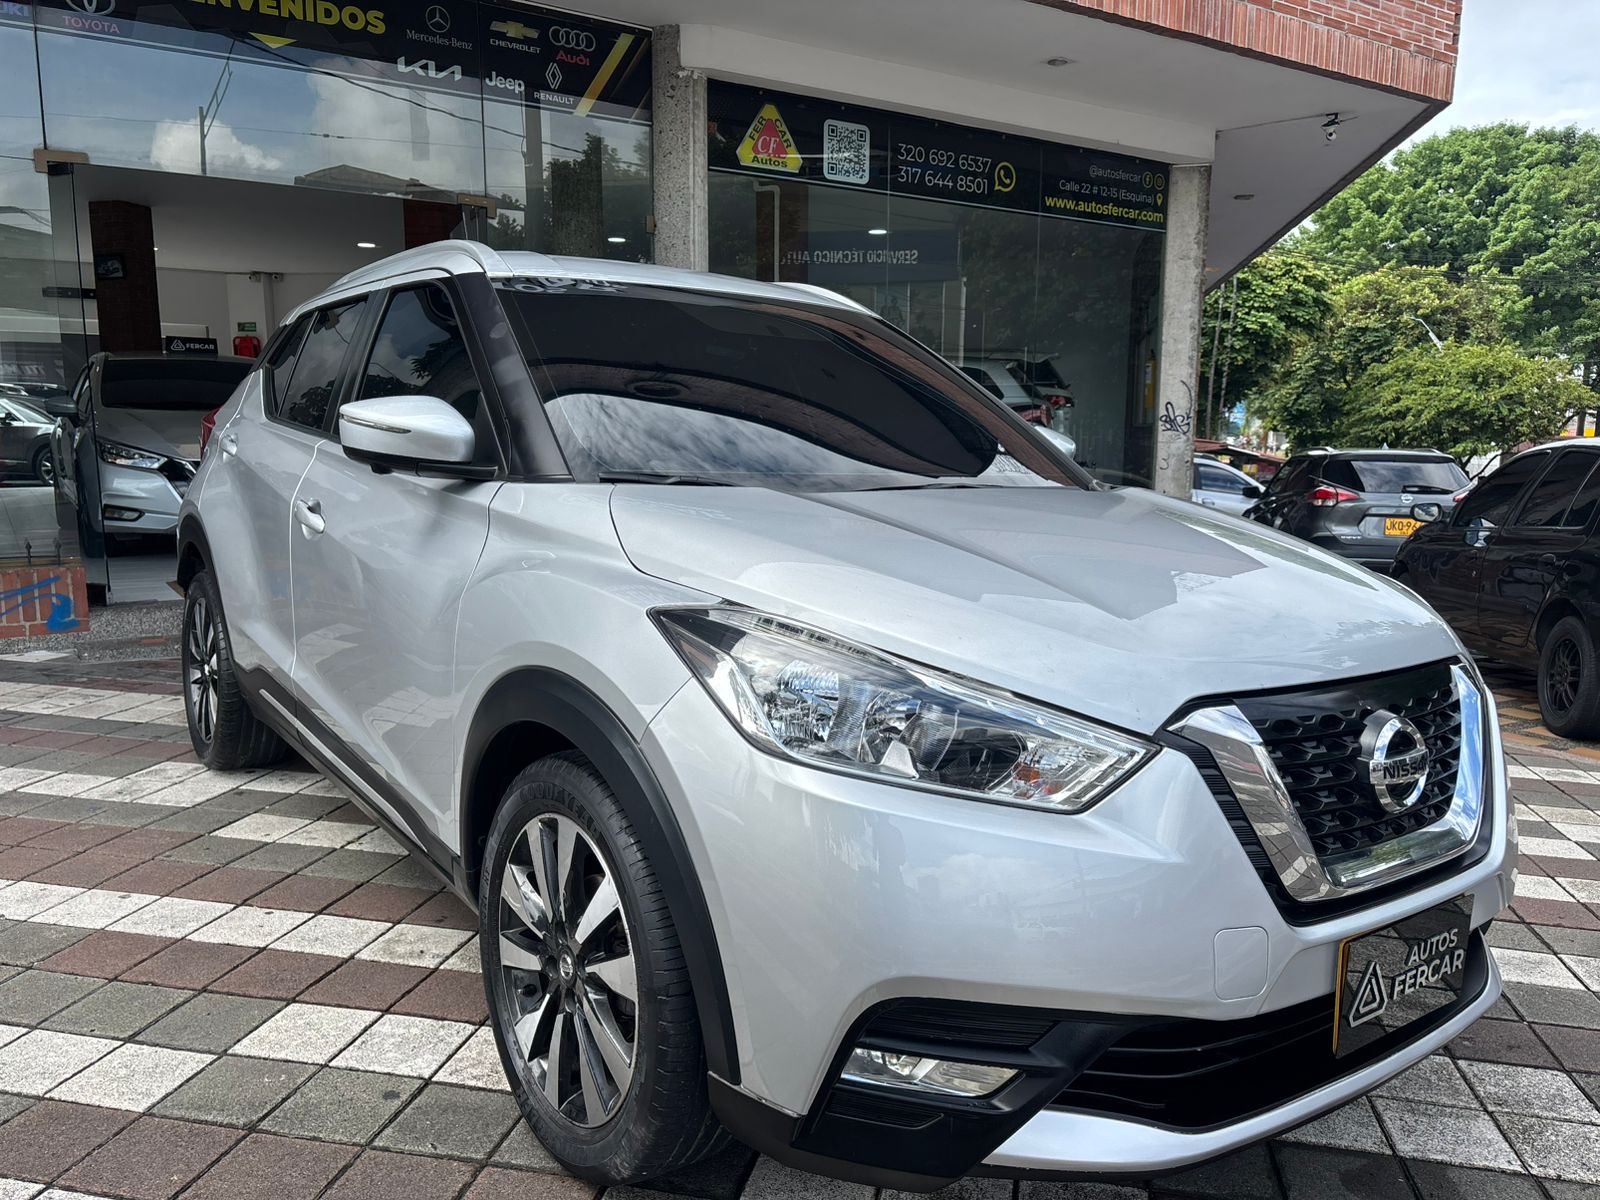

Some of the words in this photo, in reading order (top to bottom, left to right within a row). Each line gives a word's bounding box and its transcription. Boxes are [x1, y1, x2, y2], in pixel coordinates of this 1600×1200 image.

[62, 15, 120, 34] TOYOTA
[406, 29, 473, 50] Mercedes-Benz
[490, 38, 541, 54] CHEVROLET
[397, 56, 462, 81] KIA
[556, 50, 591, 66] Audi
[485, 71, 525, 94] Jeep
[533, 91, 575, 105] RENAULT
[748, 115, 767, 141] FER
[773, 118, 792, 149] CAR
[757, 135, 780, 154] CF
[751, 155, 788, 168] Autos
[897, 143, 926, 162] 320
[929, 149, 956, 168] 692
[958, 154, 992, 174] 6537
[897, 165, 922, 184] 317
[925, 170, 954, 189] 644
[956, 175, 988, 195] 8501
[1089, 164, 1142, 182] @autosfercar
[1059, 179, 1080, 192] Calle
[1081, 183, 1091, 194] 22
[1092, 185, 1099, 194] #
[1099, 186, 1118, 198] 12-15
[1119, 189, 1155, 206] (Esquina)
[1044, 195, 1164, 222] www.autosfercar.com
[185, 342, 215, 350] FERCAR
[1408, 928, 1459, 967] AUTOS
[1391, 948, 1465, 1001] FERCAR
